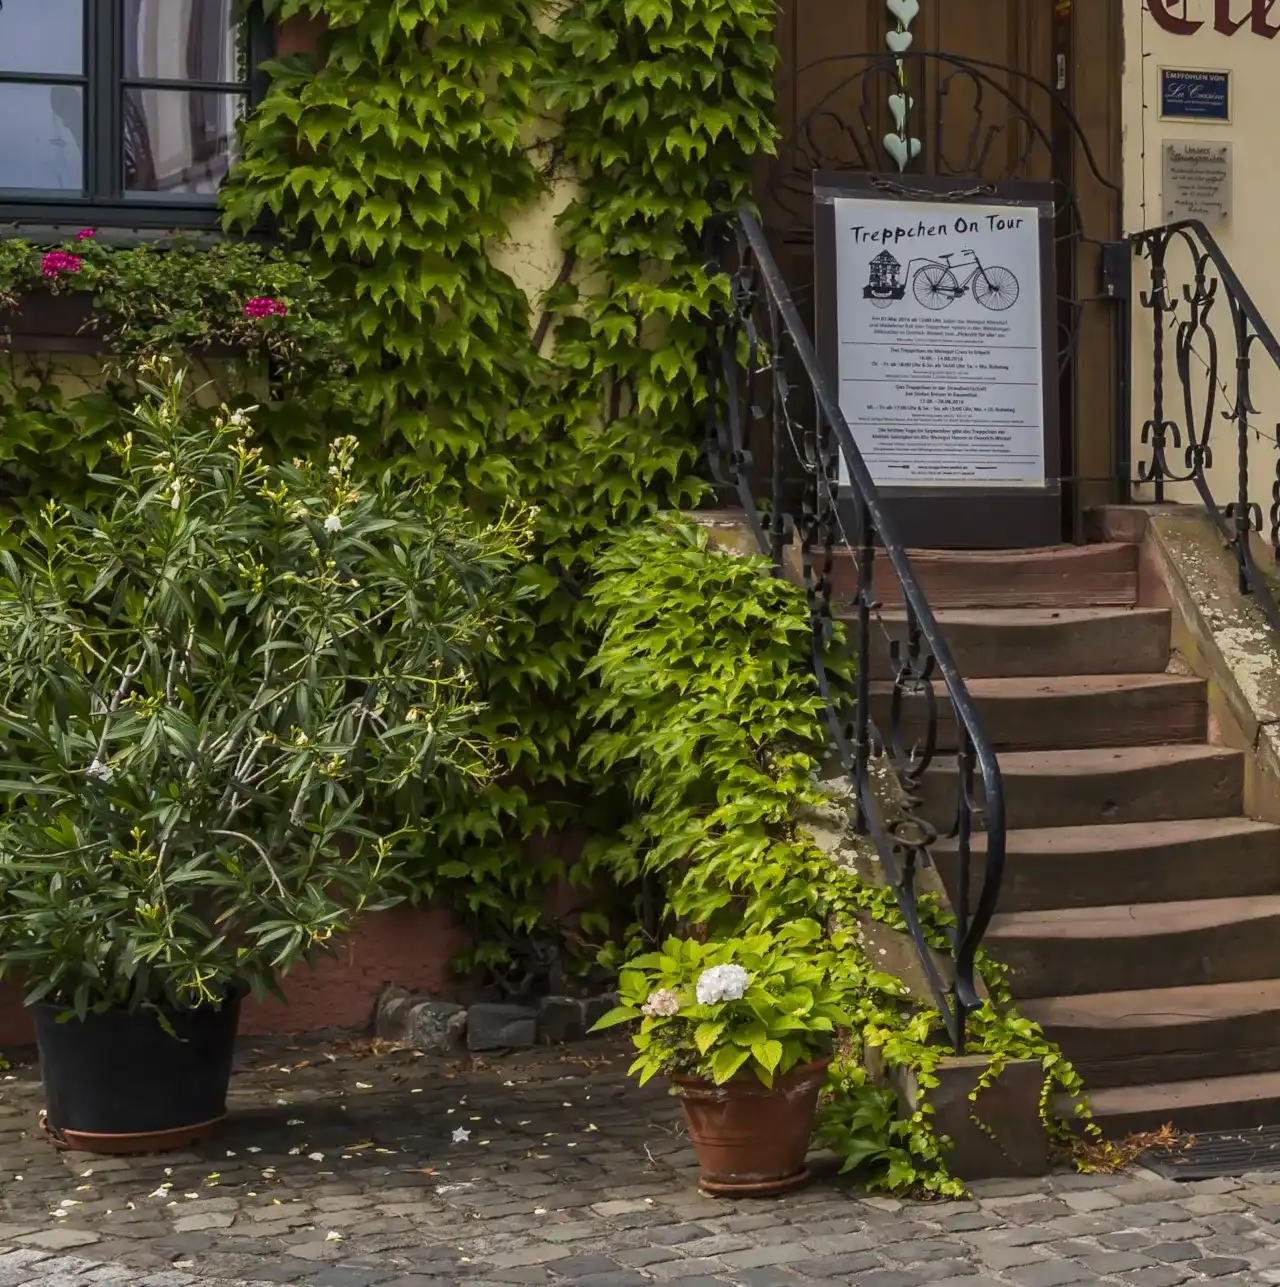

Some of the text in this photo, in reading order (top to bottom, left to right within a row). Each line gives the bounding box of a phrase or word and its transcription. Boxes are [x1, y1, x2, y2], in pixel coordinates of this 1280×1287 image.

[1165, 71, 1208, 80] EMPFOHLEN
[850, 214, 1025, 244] Treppchen On Tour
